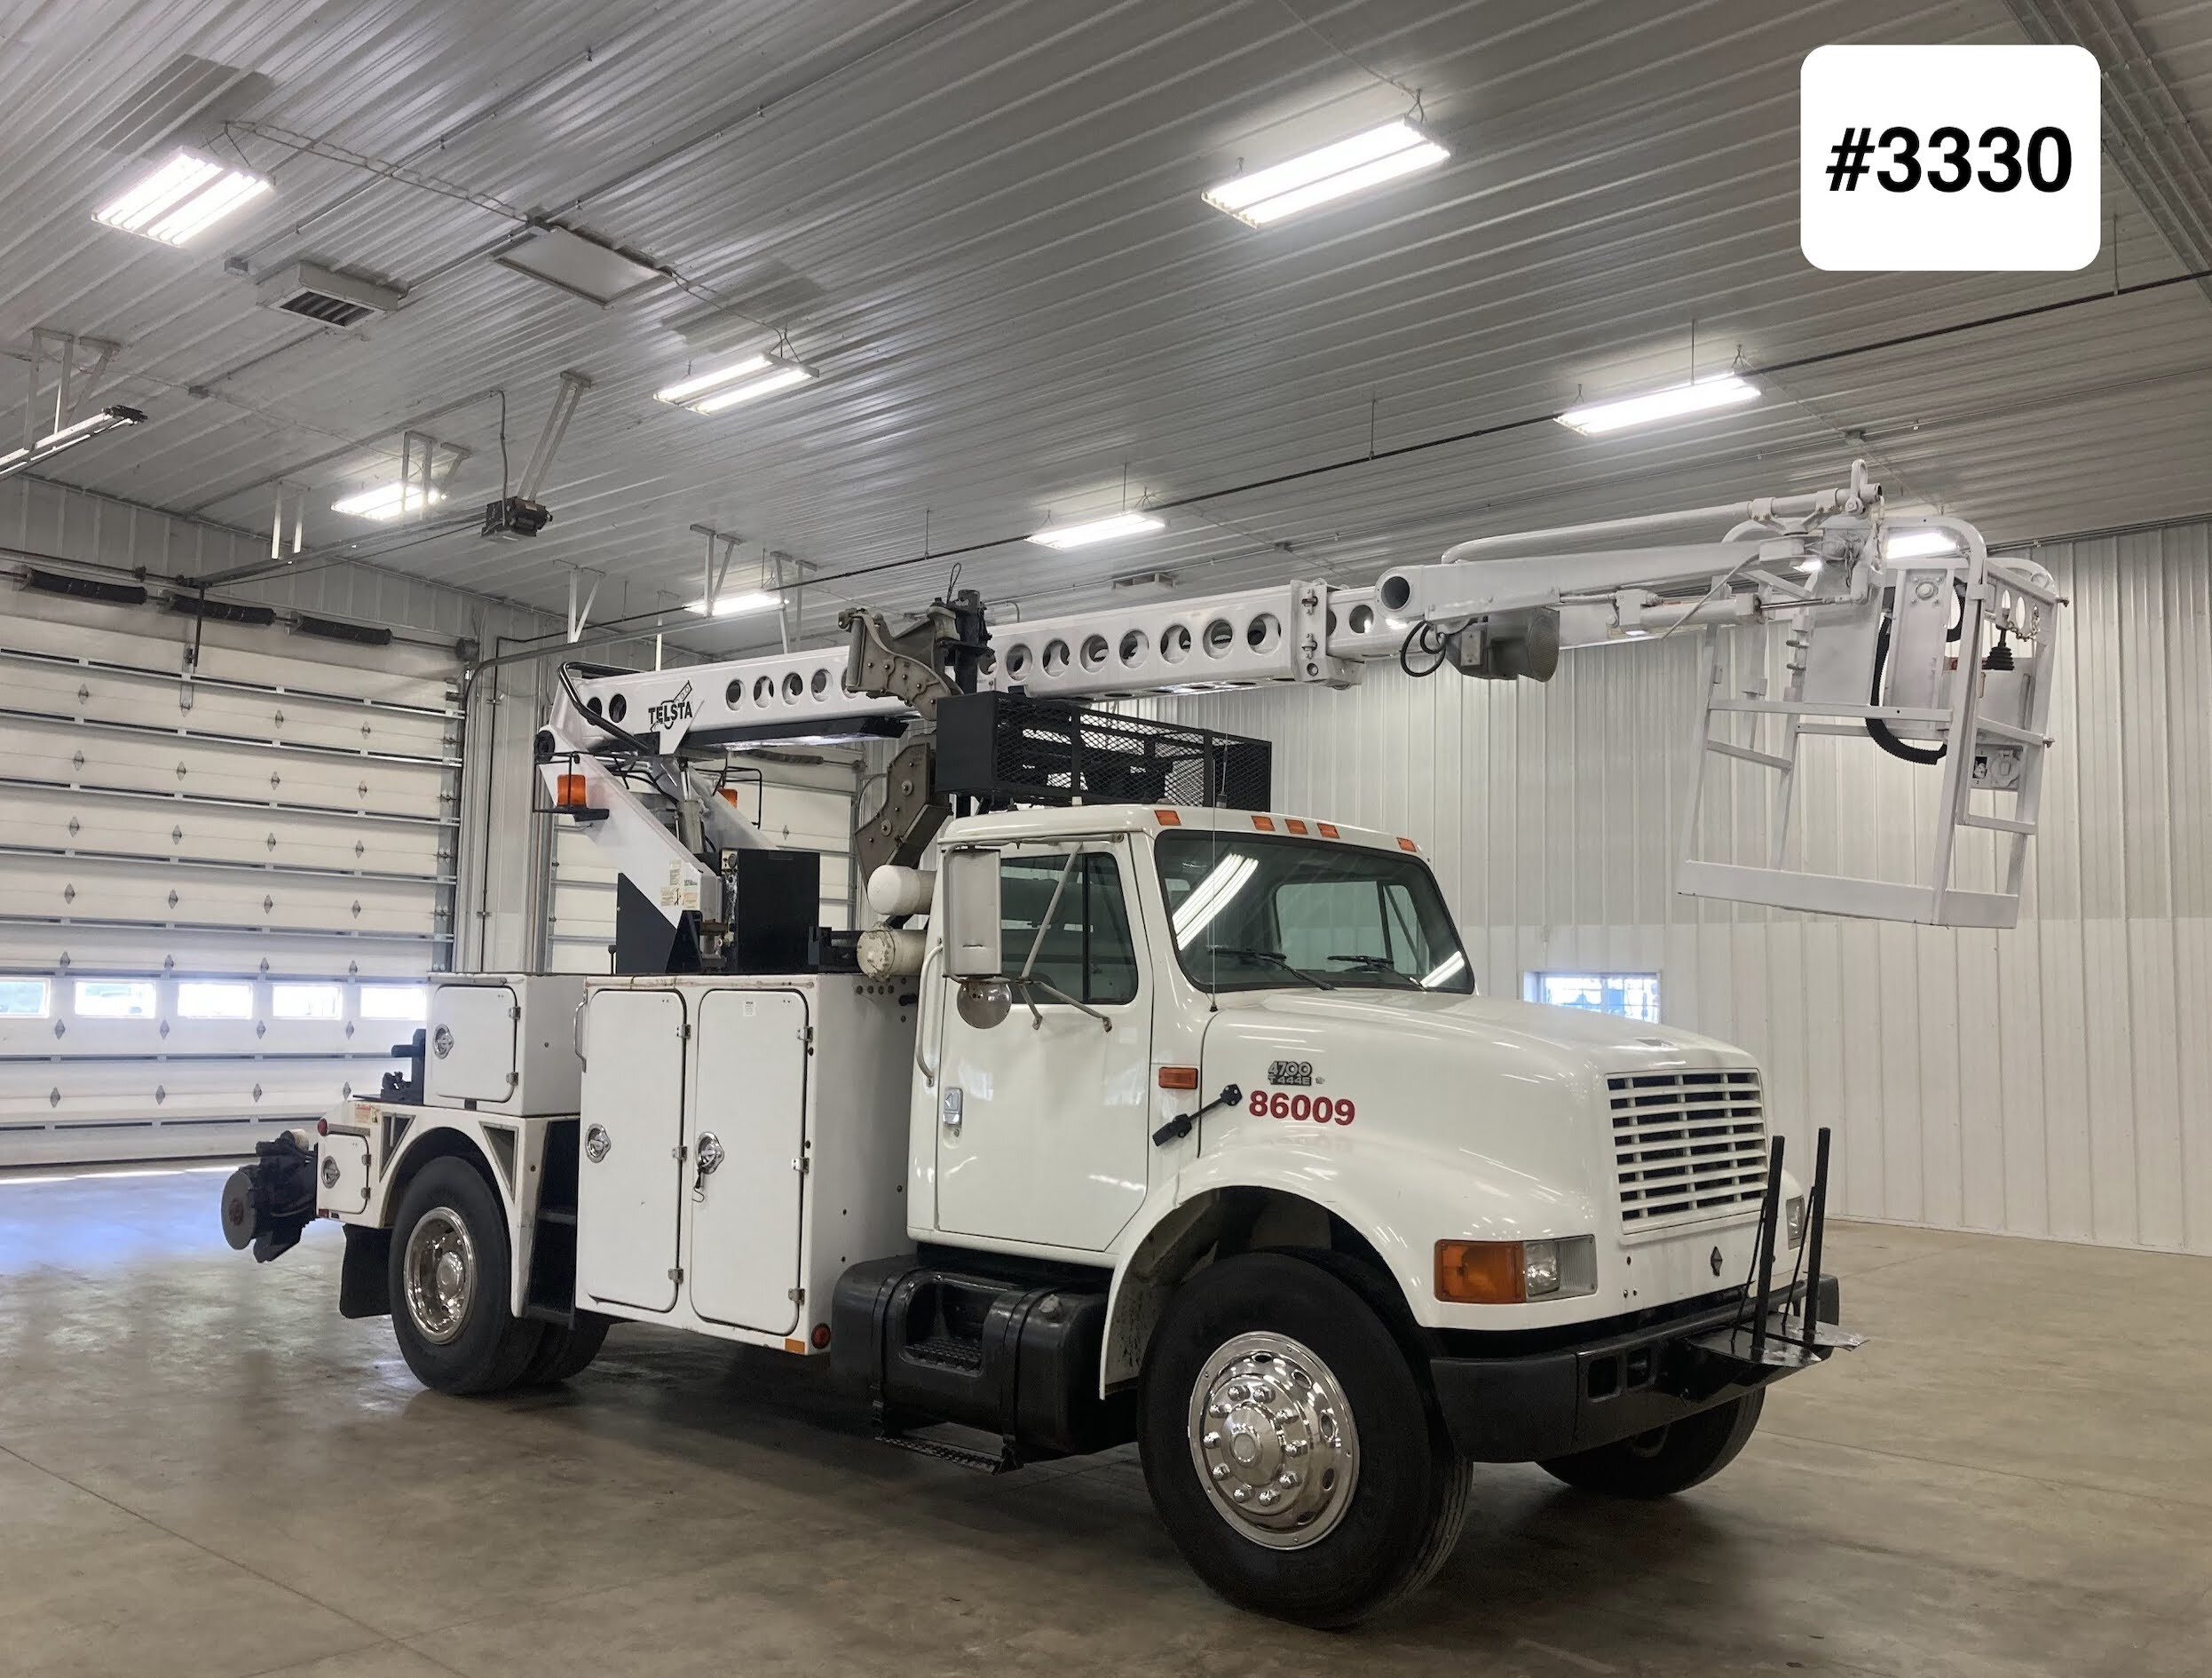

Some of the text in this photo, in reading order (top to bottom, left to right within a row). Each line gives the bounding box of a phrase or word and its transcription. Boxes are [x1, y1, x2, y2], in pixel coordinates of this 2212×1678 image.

[648, 701, 693, 724] TELSTA
[1268, 1061, 1312, 1077] 4700
[1277, 1076, 1311, 1085] 444E
[1249, 1089, 1355, 1126] 86009
